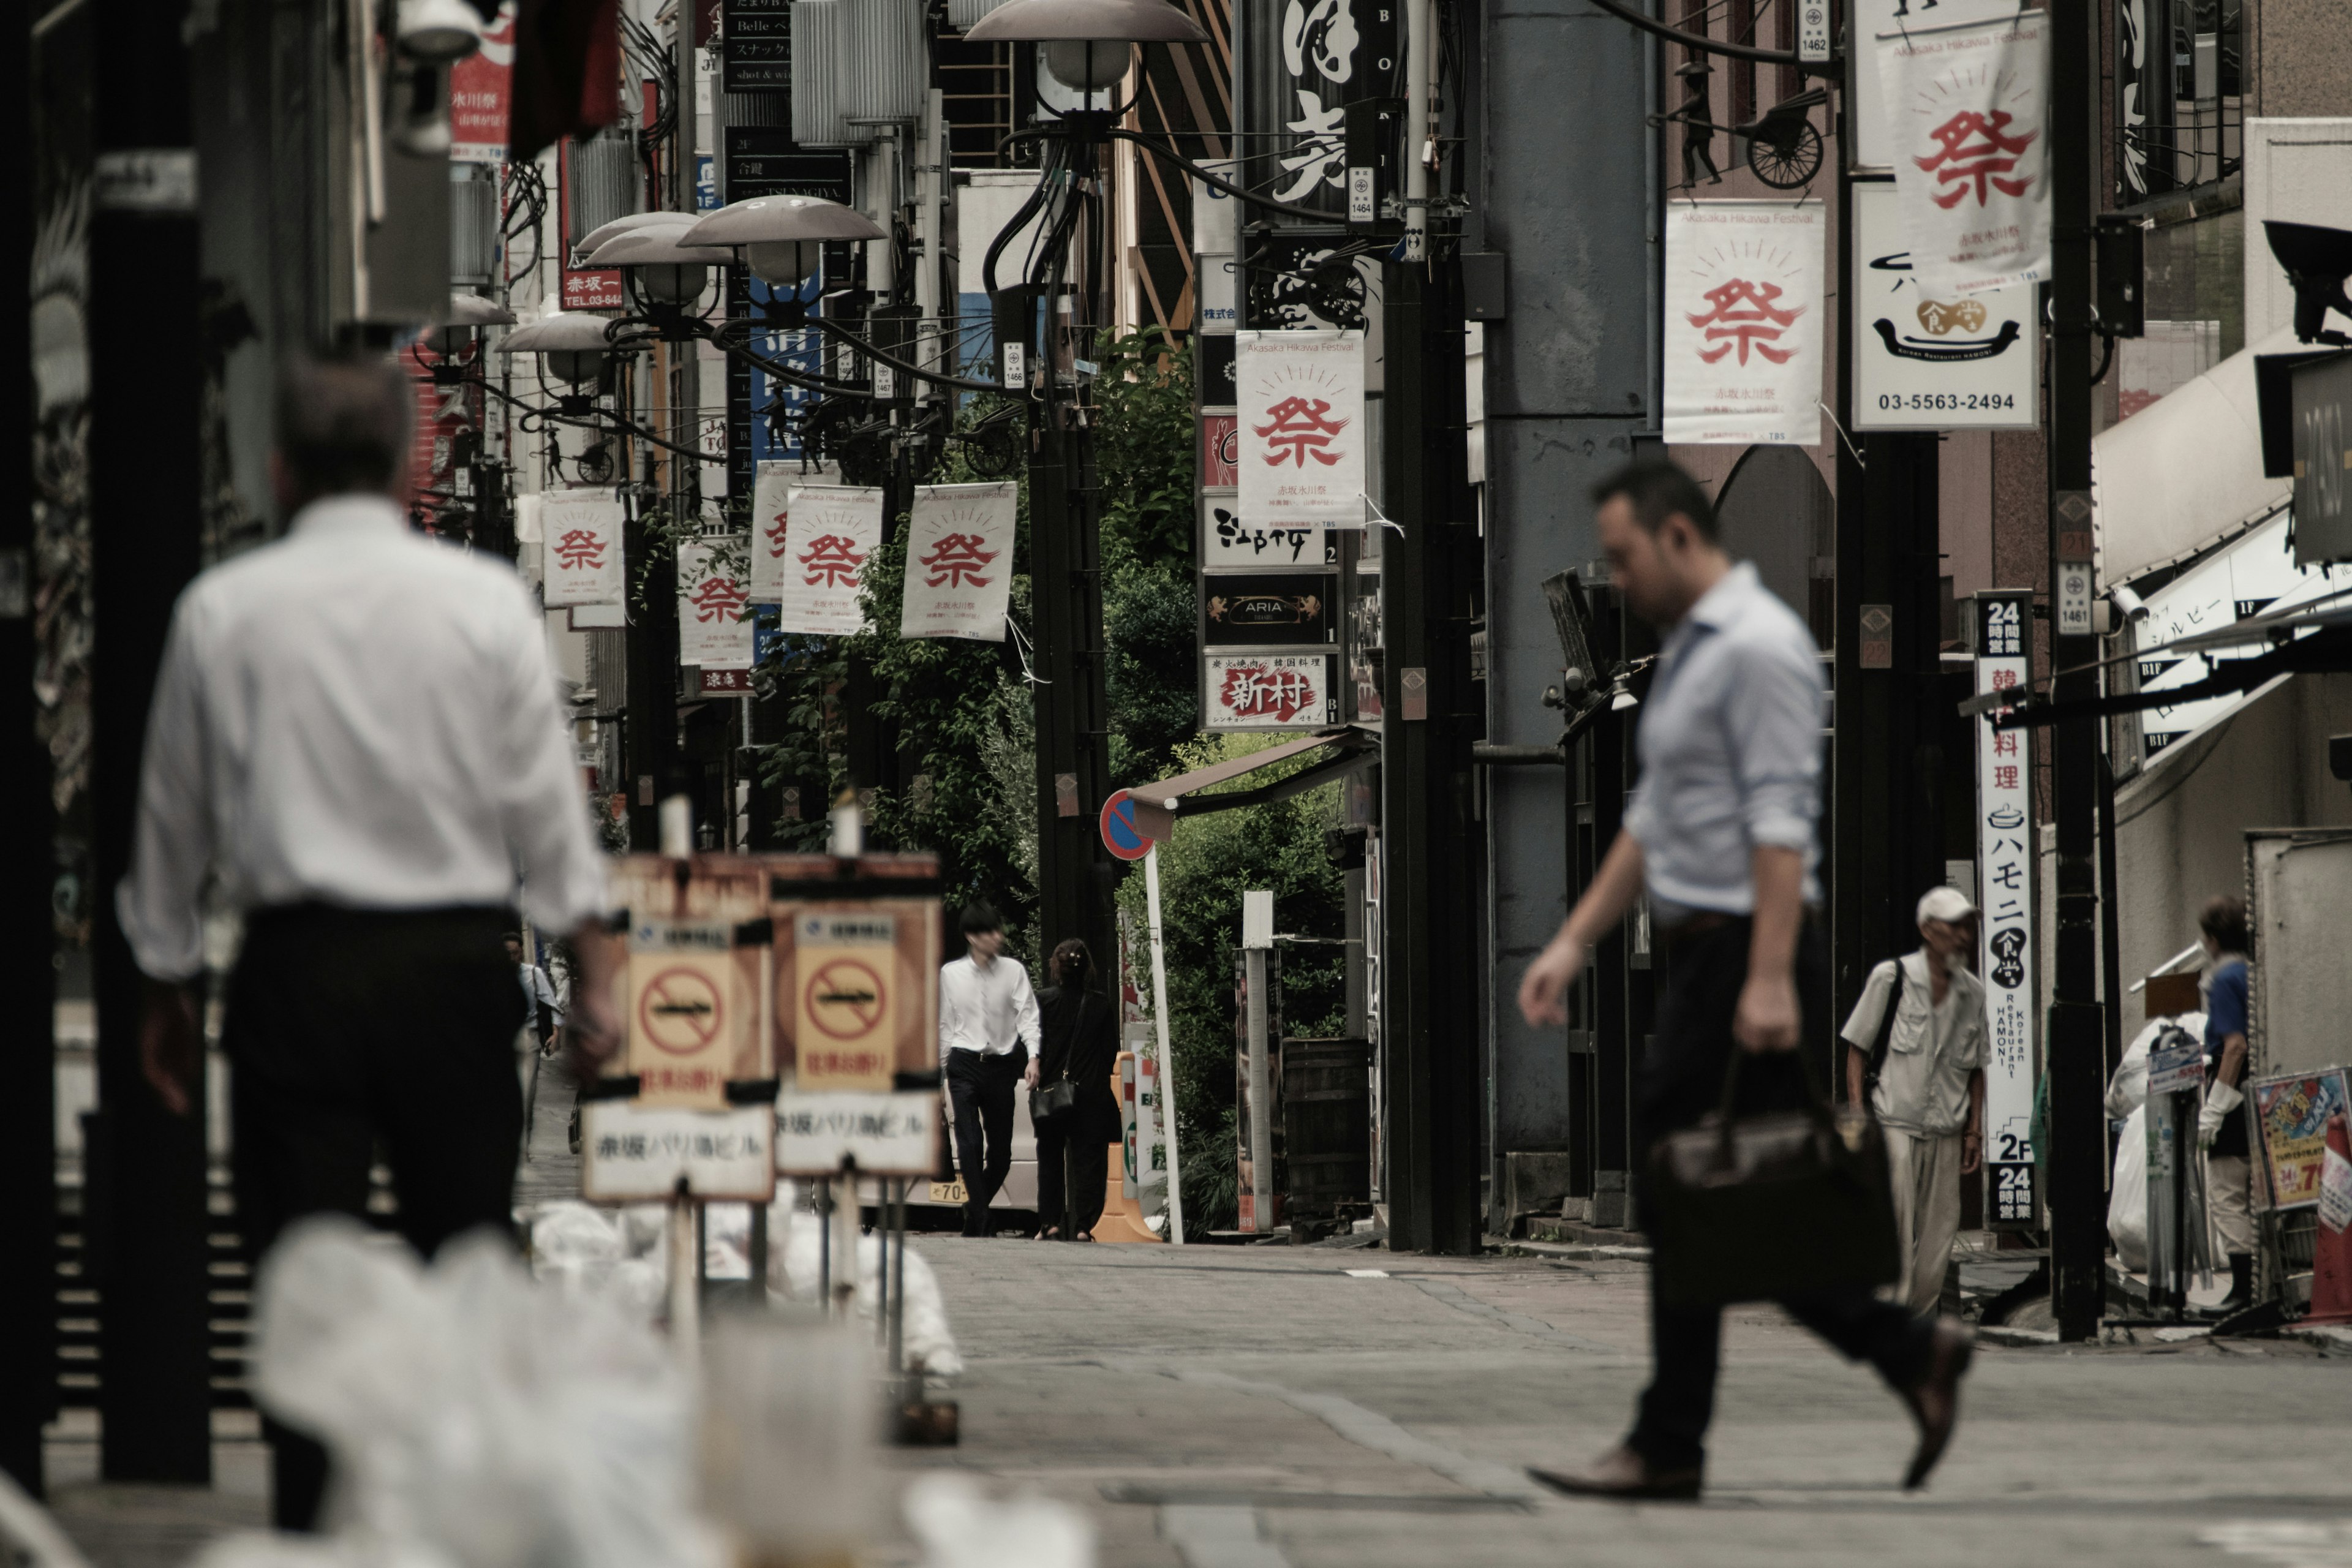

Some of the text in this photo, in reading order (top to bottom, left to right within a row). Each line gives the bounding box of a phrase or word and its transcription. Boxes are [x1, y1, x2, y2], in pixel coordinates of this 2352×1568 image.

[737, 21, 769, 31] Belle
[736, 43, 785, 56] スナック
[1803, 39, 1826, 50] 1462
[1894, 29, 2038, 57] Akasaka Hikawa Festival
[737, 70, 760, 80] shot
[1912, 108, 2040, 209] 祭
[1352, 204, 1371, 213] 1464
[1682, 213, 1814, 224] Akasaka Hikawa Festival
[1684, 277, 1807, 368] 祭
[1921, 303, 1982, 333] 食堂
[1247, 342, 1354, 353] Akasaka Hikawa Festival
[1898, 347, 1922, 357] Korean
[1964, 349, 1994, 359] HAMONI
[1879, 394, 2015, 410] 03-5563-2494
[1251, 396, 1352, 469] 祭
[1278, 485, 1326, 496] 赤坂氷川祭
[552, 529, 609, 571] 祭
[1325, 546, 1336, 563] 2
[796, 533, 870, 589] 祭
[918, 532, 1001, 590] 祭
[688, 577, 750, 624] 祭
[1245, 602, 1282, 612] ARIA
[2239, 600, 2255, 614] 1F
[1988, 602, 2020, 624] 24
[2062, 611, 2087, 622] 1461
[1327, 628, 1335, 643] 1
[1988, 625, 2019, 638] 時間
[1988, 639, 2021, 654] 営業
[2141, 663, 2162, 676] B1F
[1227, 672, 1307, 712] 新村
[2149, 733, 2169, 747] B1F
[1991, 838, 2024, 922] ハモニ
[1996, 930, 2021, 986] 食堂
[1997, 1007, 2006, 1066] HAMONI
[1999, 1134, 2031, 1161] 2F
[1999, 1168, 2031, 1189] 24
[1999, 1189, 2031, 1204] 時間
